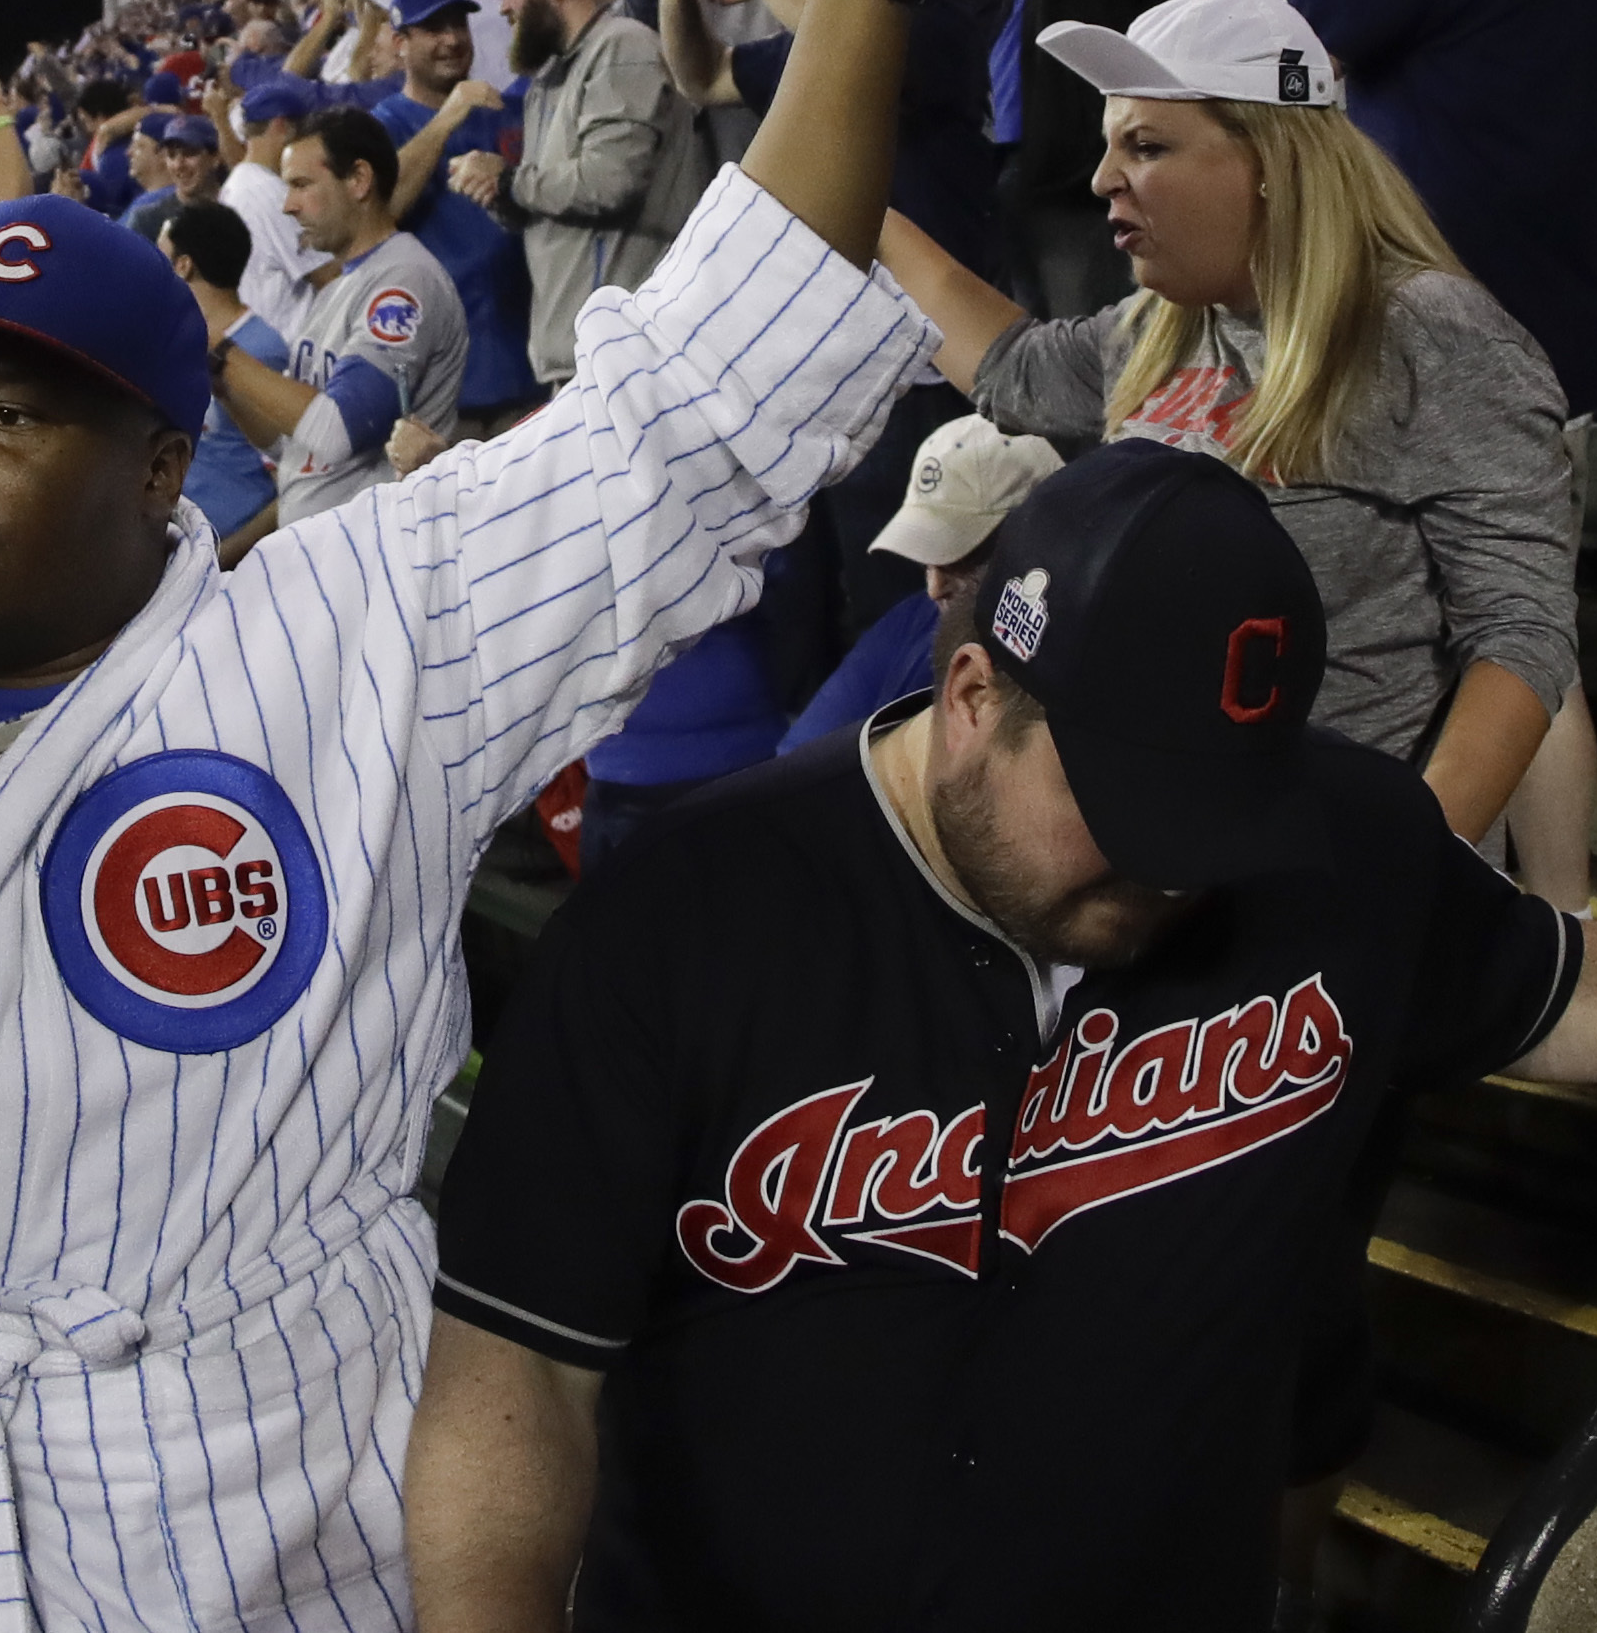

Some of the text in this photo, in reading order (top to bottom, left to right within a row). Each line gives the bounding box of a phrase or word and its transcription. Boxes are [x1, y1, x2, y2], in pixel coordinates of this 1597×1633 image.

[996, 602, 1038, 653] SERIES
[1003, 584, 1044, 633] WORLD
[1220, 616, 1286, 724] C
[93, 803, 279, 997] CUBS
[675, 971, 1354, 1294] Indians
